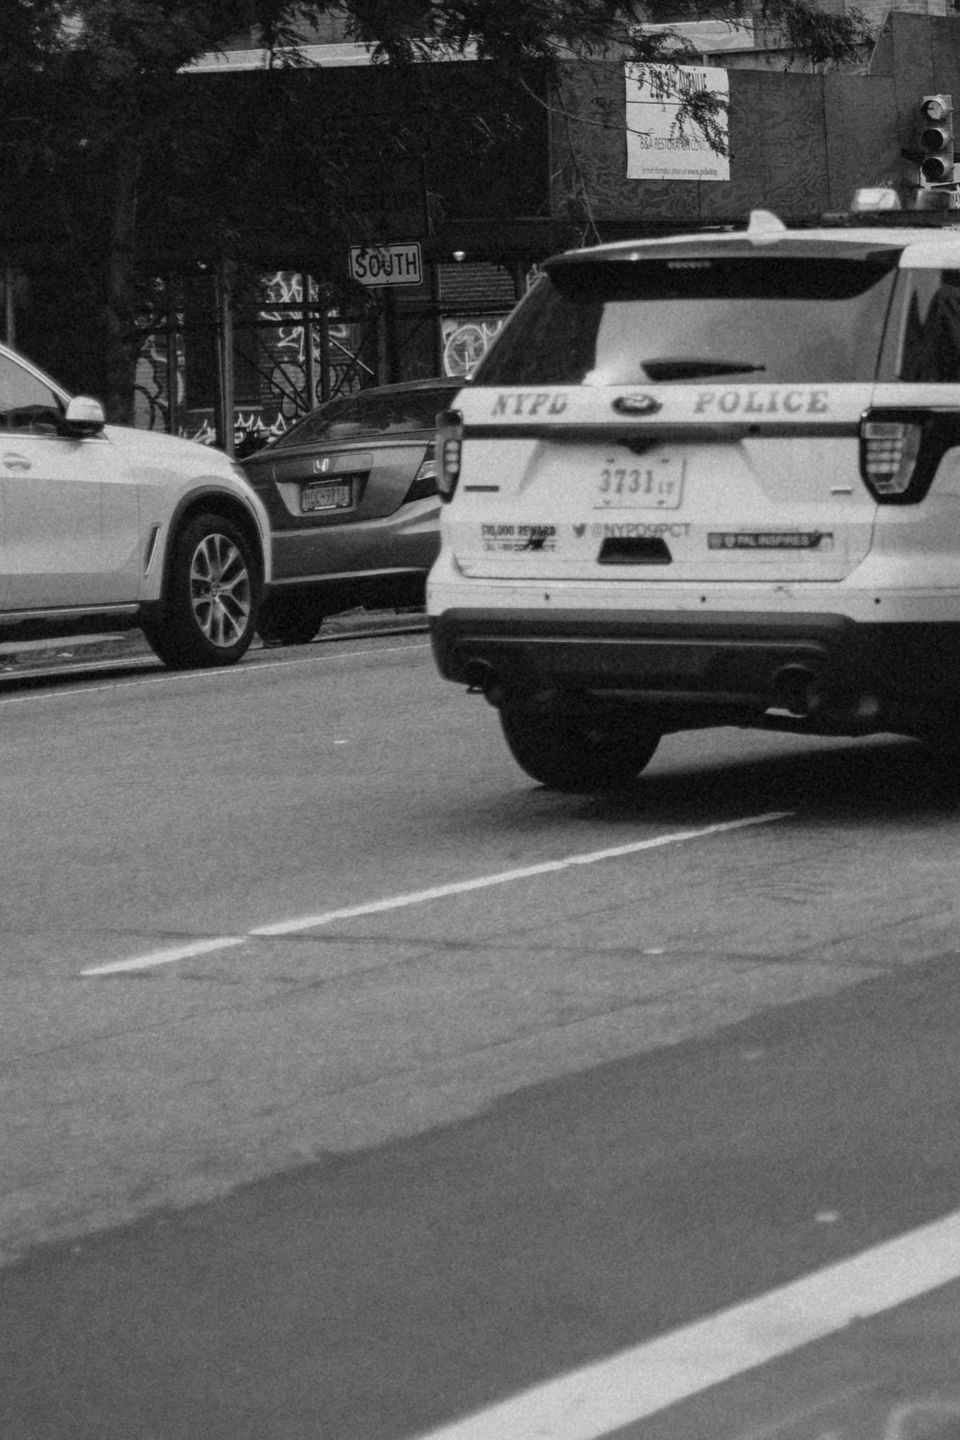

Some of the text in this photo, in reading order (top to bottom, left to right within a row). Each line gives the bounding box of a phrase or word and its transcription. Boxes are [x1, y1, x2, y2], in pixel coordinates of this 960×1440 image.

[354, 252, 418, 279] SOUTH
[490, 393, 568, 416] NYPD
[694, 391, 830, 414] POLICE
[599, 469, 653, 494] 3731
[518, 525, 556, 537] REWARD
[591, 523, 691, 538] @NYPD9PCT
[757, 536, 810, 546] INSPIRES
